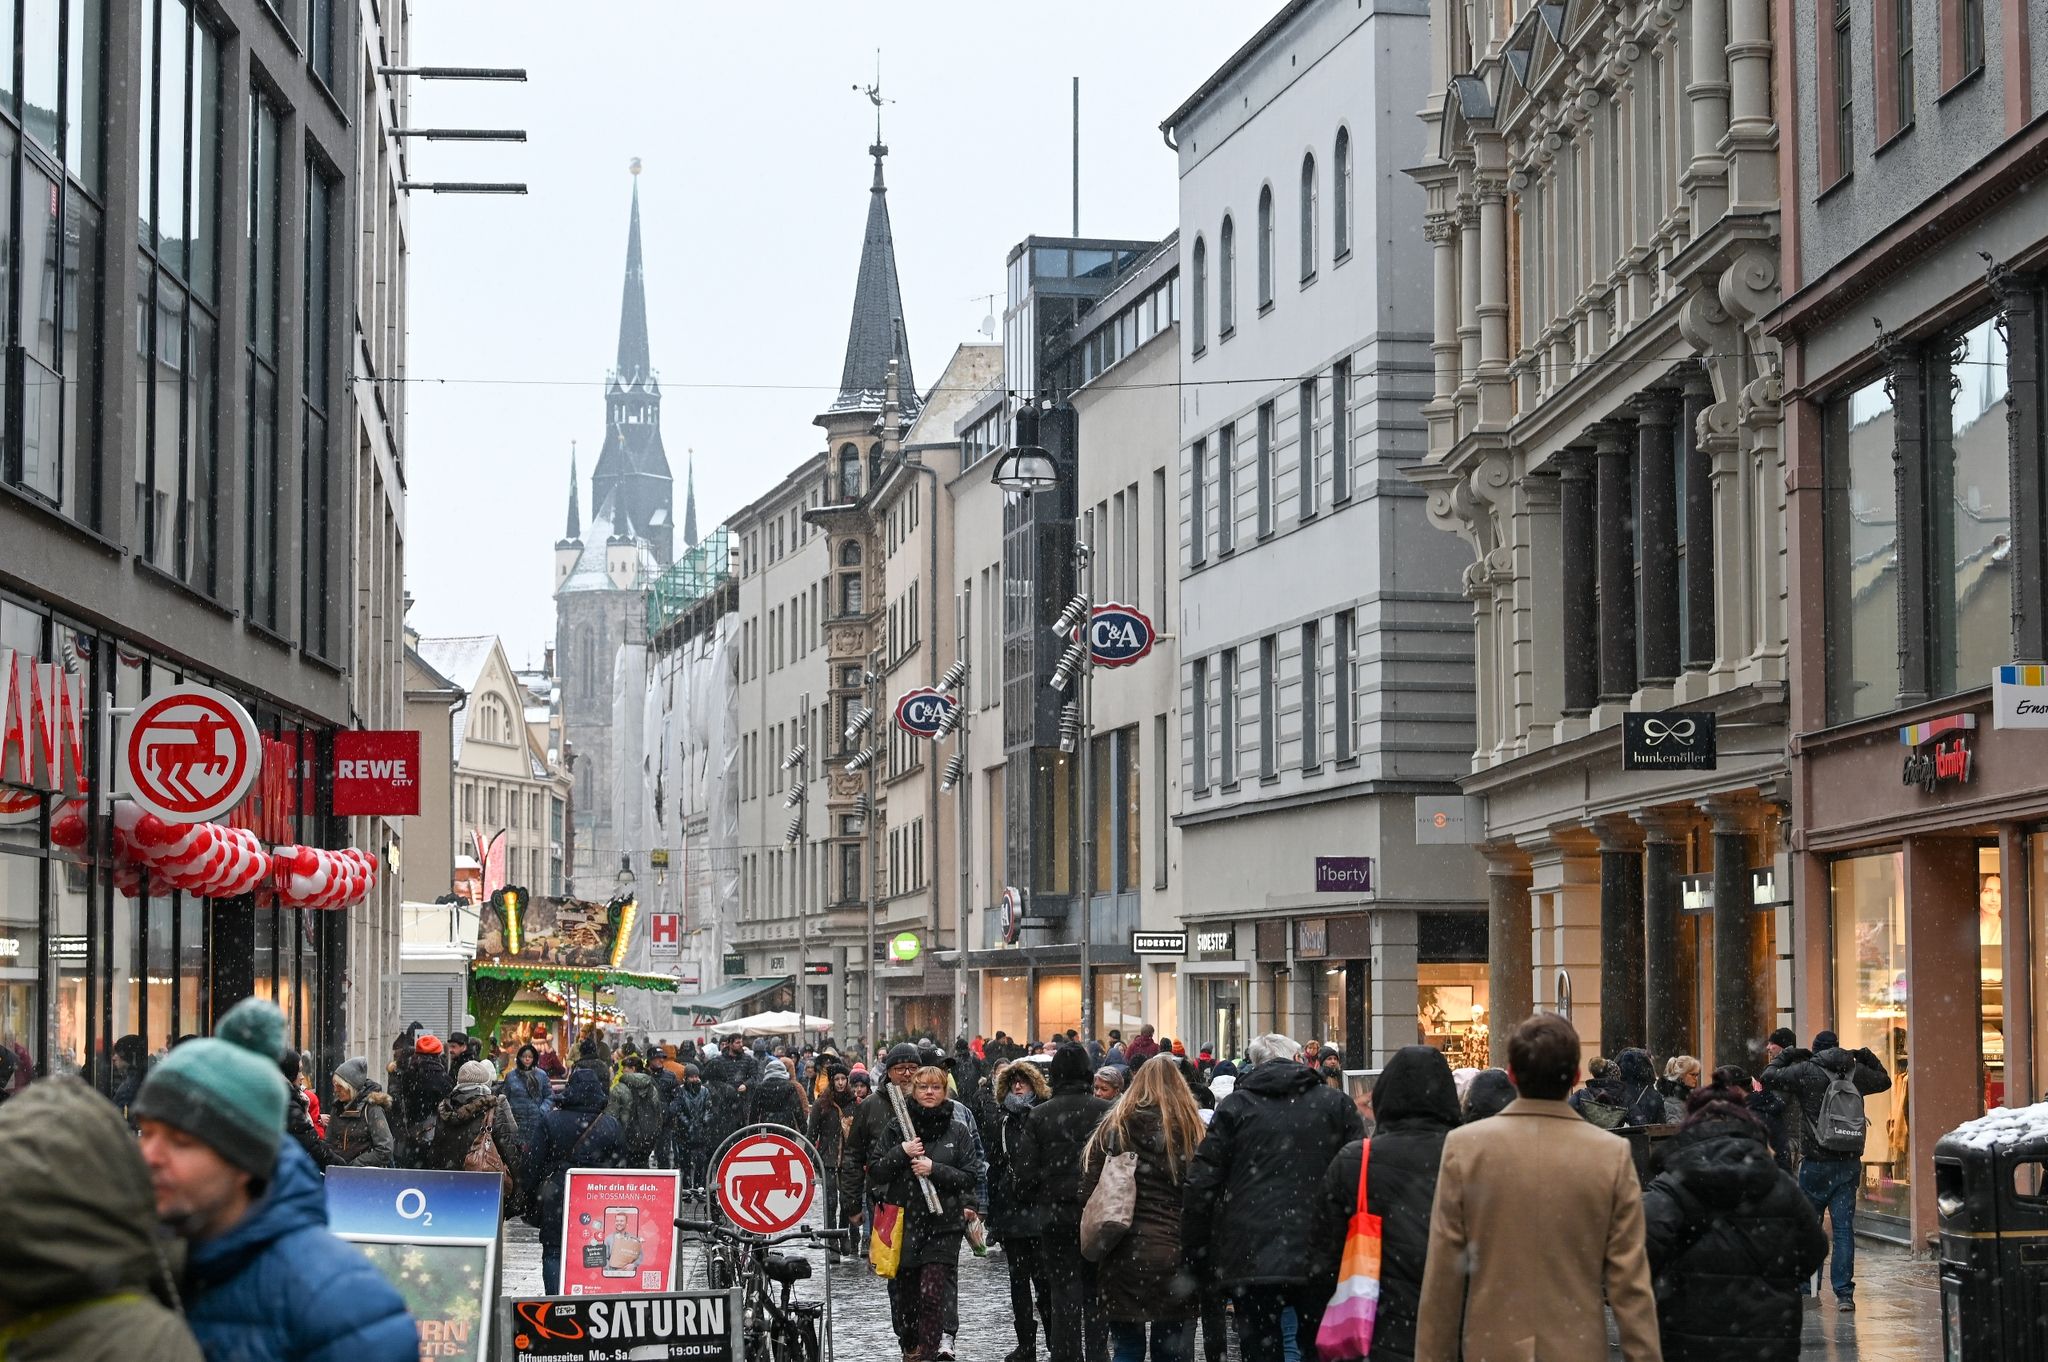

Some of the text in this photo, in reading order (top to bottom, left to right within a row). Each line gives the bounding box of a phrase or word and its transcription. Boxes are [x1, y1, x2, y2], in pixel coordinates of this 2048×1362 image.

[1091, 621, 1140, 649] C&A
[909, 701, 946, 724] C&A
[1633, 751, 1706, 763] hunkemöller
[338, 759, 407, 779] REWE
[391, 779, 413, 787] CITY
[1317, 864, 1368, 884] liberty
[1137, 939, 1182, 947] SIDESTEP
[1197, 932, 1228, 951] SIDESTEP
[586, 1192, 599, 1200] Die
[587, 1183, 658, 1191] Mehr drin für dich.
[588, 1298, 725, 1340] SATURN
[416, 1320, 467, 1342] RN
[518, 1351, 584, 1362] Öffnungszeiten
[669, 1345, 700, 1356] 19:00
[703, 1344, 722, 1355] Uhr
